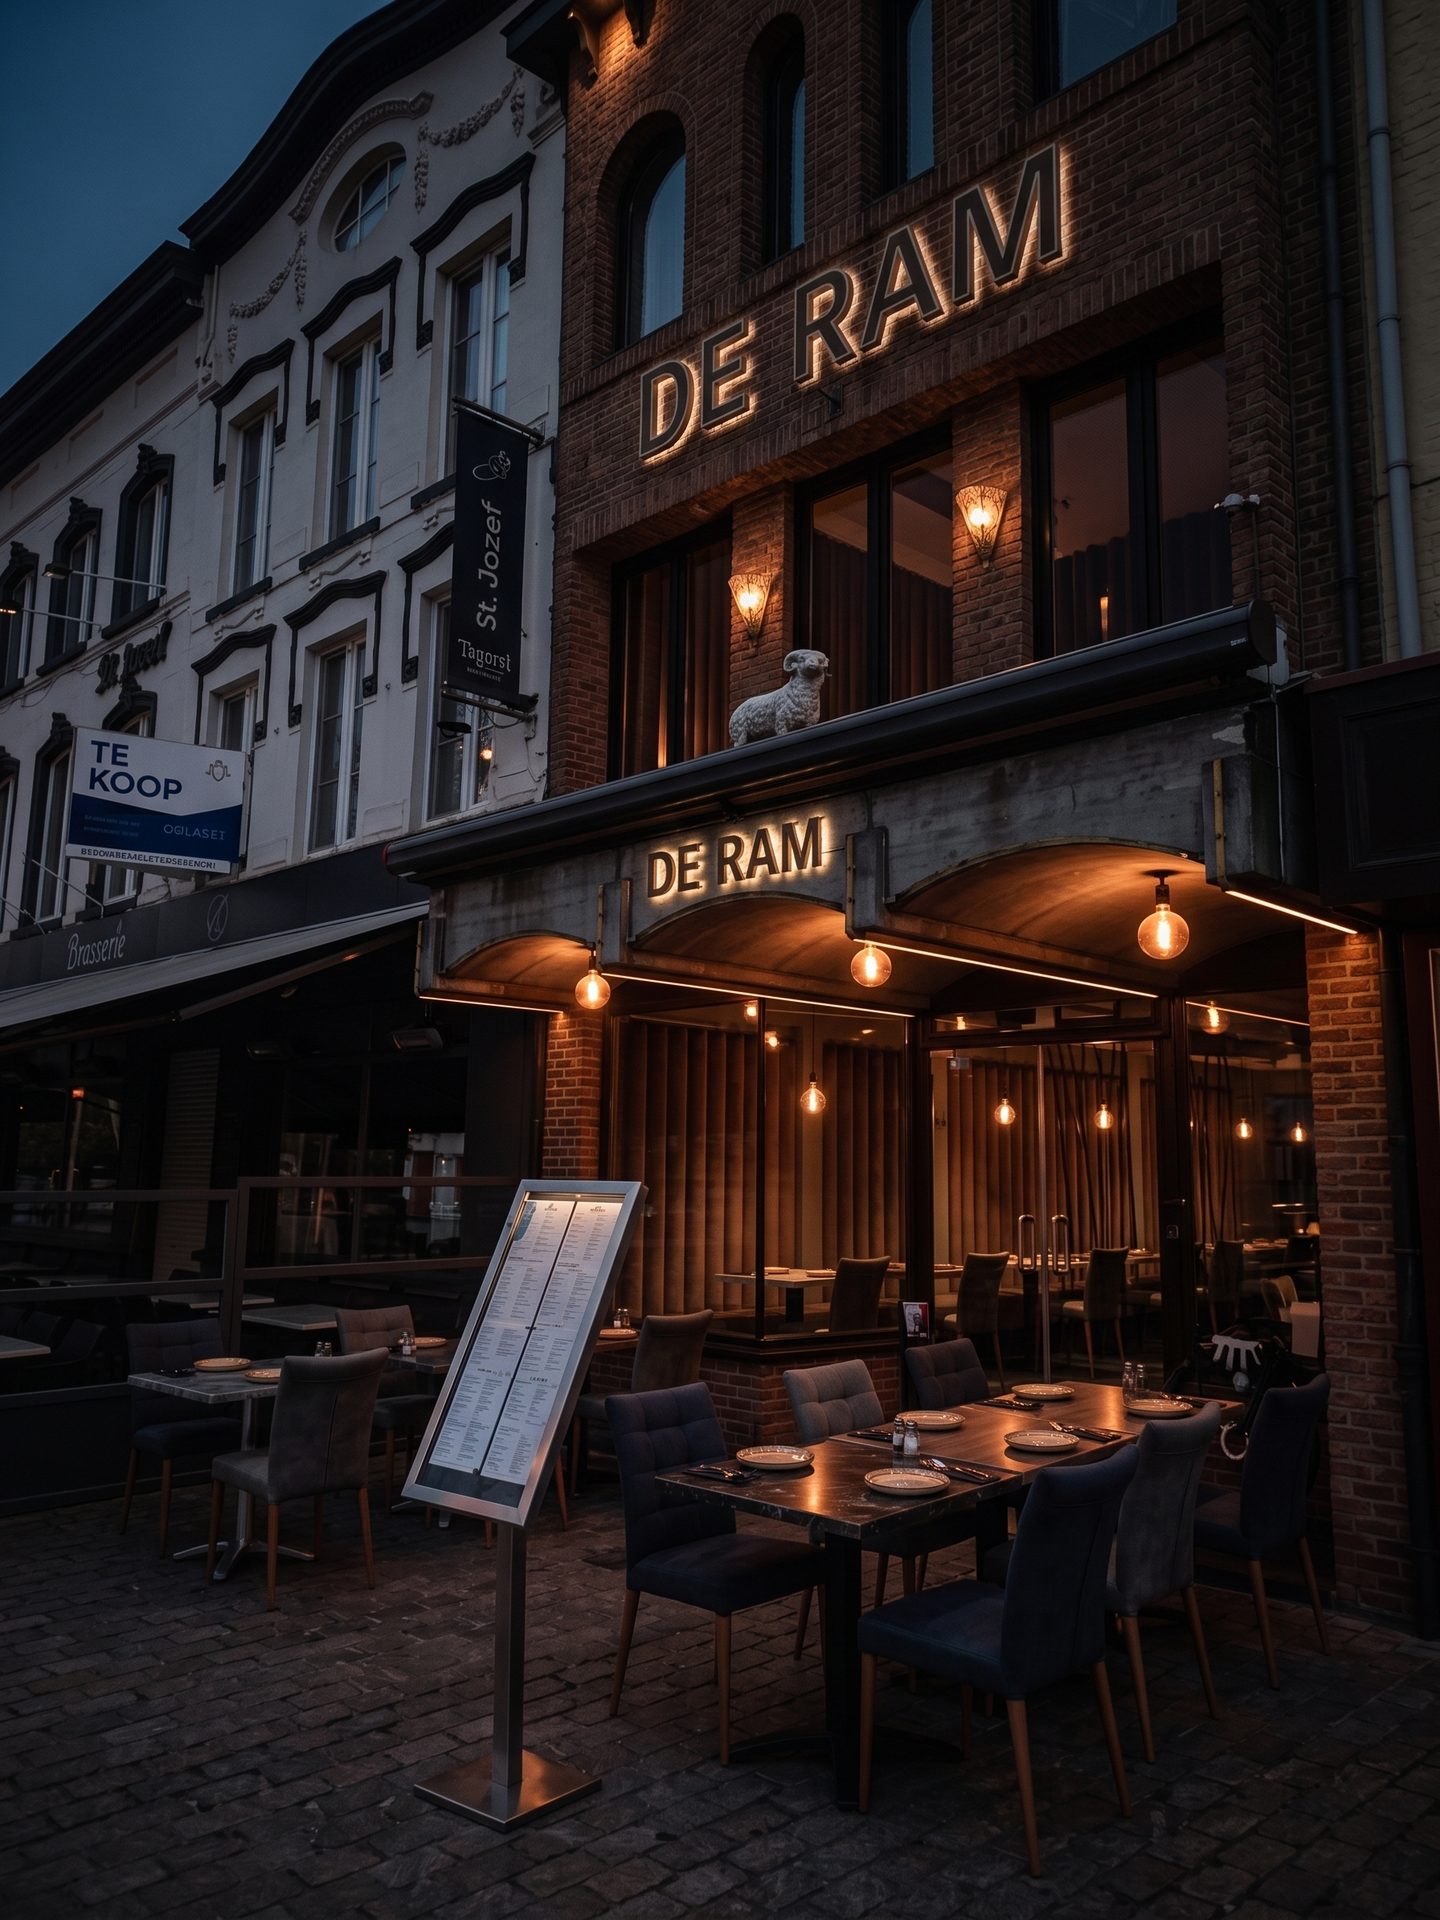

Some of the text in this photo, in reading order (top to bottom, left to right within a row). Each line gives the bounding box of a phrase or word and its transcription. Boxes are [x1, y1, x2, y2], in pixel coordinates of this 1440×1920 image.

[639, 143, 1063, 463] DE RAM
[476, 498, 504, 633] St. Jozef
[89, 767, 183, 800] KOOP
[90, 739, 129, 767] TE
[647, 816, 824, 898] DE RAM
[66, 919, 127, 971] Brasserie
